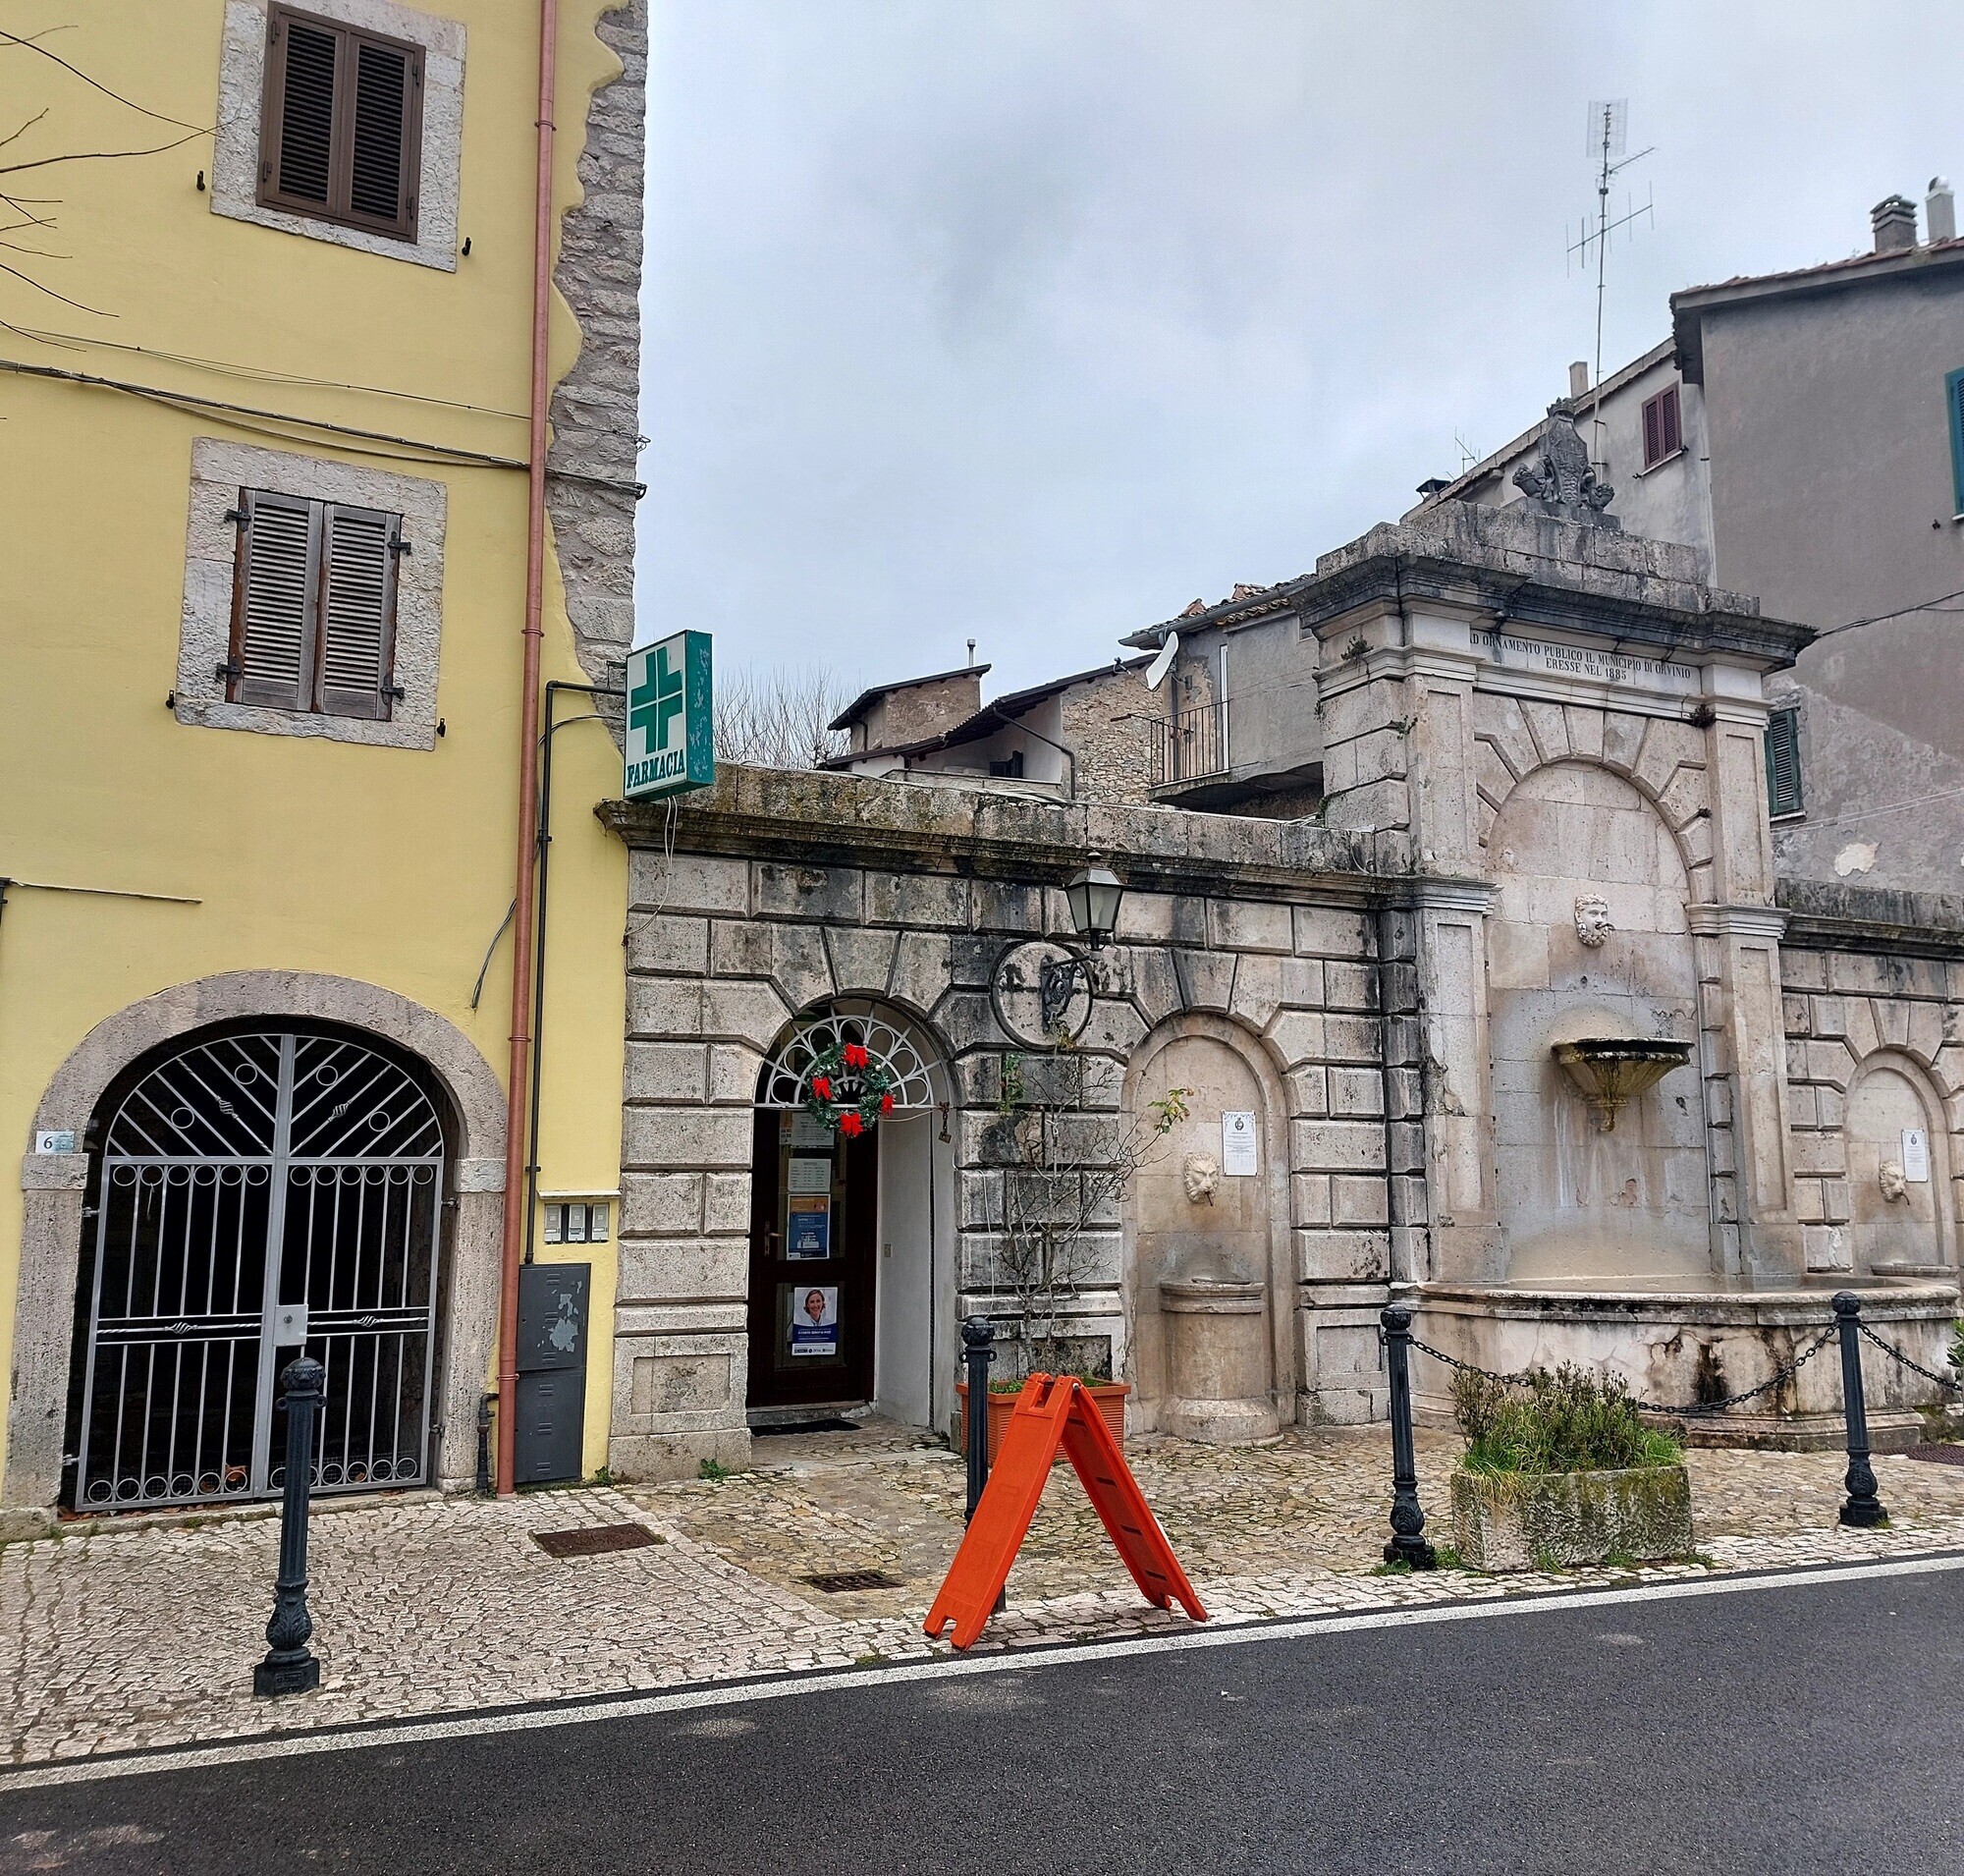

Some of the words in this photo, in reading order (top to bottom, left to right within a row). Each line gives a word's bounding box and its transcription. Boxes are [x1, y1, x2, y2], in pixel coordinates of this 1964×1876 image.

[1483, 635, 1541, 655] ORNAMENTO
[1544, 645, 1582, 661] PUBLICO
[1586, 650, 1595, 664] IL
[1599, 654, 1641, 671] MUNICIPIO
[1644, 662, 1653, 673] DI
[1655, 663, 1691, 679] ORVINIO
[1546, 657, 1581, 673] ERESSE
[1584, 664, 1602, 677] NEL
[1606, 668, 1627, 680] 1885
[627, 748, 685, 790] FARMACIA
[43, 1135, 53, 1149] 6
